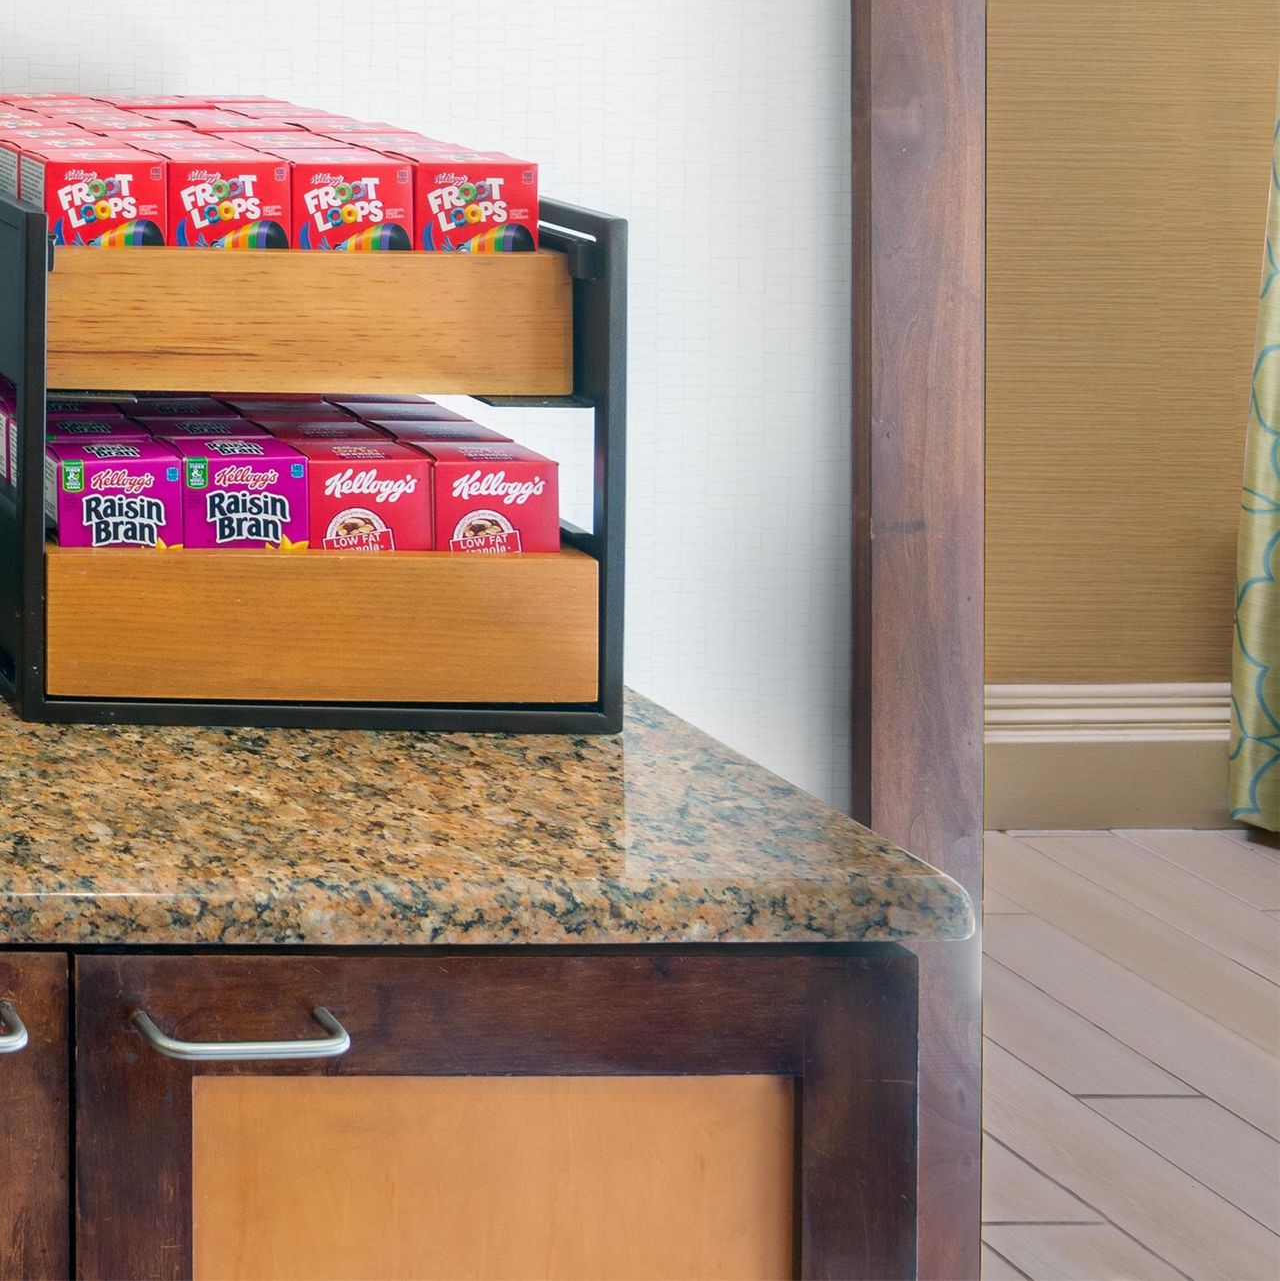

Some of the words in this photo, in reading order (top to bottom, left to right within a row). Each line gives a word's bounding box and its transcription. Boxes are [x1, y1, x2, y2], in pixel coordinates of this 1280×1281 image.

[57, 174, 133, 211] FROOT
[180, 174, 257, 211] FROOT
[304, 177, 380, 215] FROOT
[427, 177, 504, 215] FROOT
[67, 197, 137, 229] LOOPS
[189, 197, 261, 229] LOOPS
[313, 200, 384, 233] LOOPS
[437, 200, 508, 233] LOOPS
[91, 469, 155, 494] Kellogg's
[214, 465, 279, 490] Kellogg's
[324, 468, 418, 503] Kellogg's
[452, 470, 546, 505] Kellogg's
[82, 494, 166, 526] Raisin
[206, 491, 290, 522] Raisin
[92, 519, 157, 547] Bran
[216, 516, 282, 543] Bran
[333, 535, 359, 548] LOW
[362, 533, 382, 543] FAT
[460, 536, 486, 549] LOW
[489, 534, 508, 545] FAT
